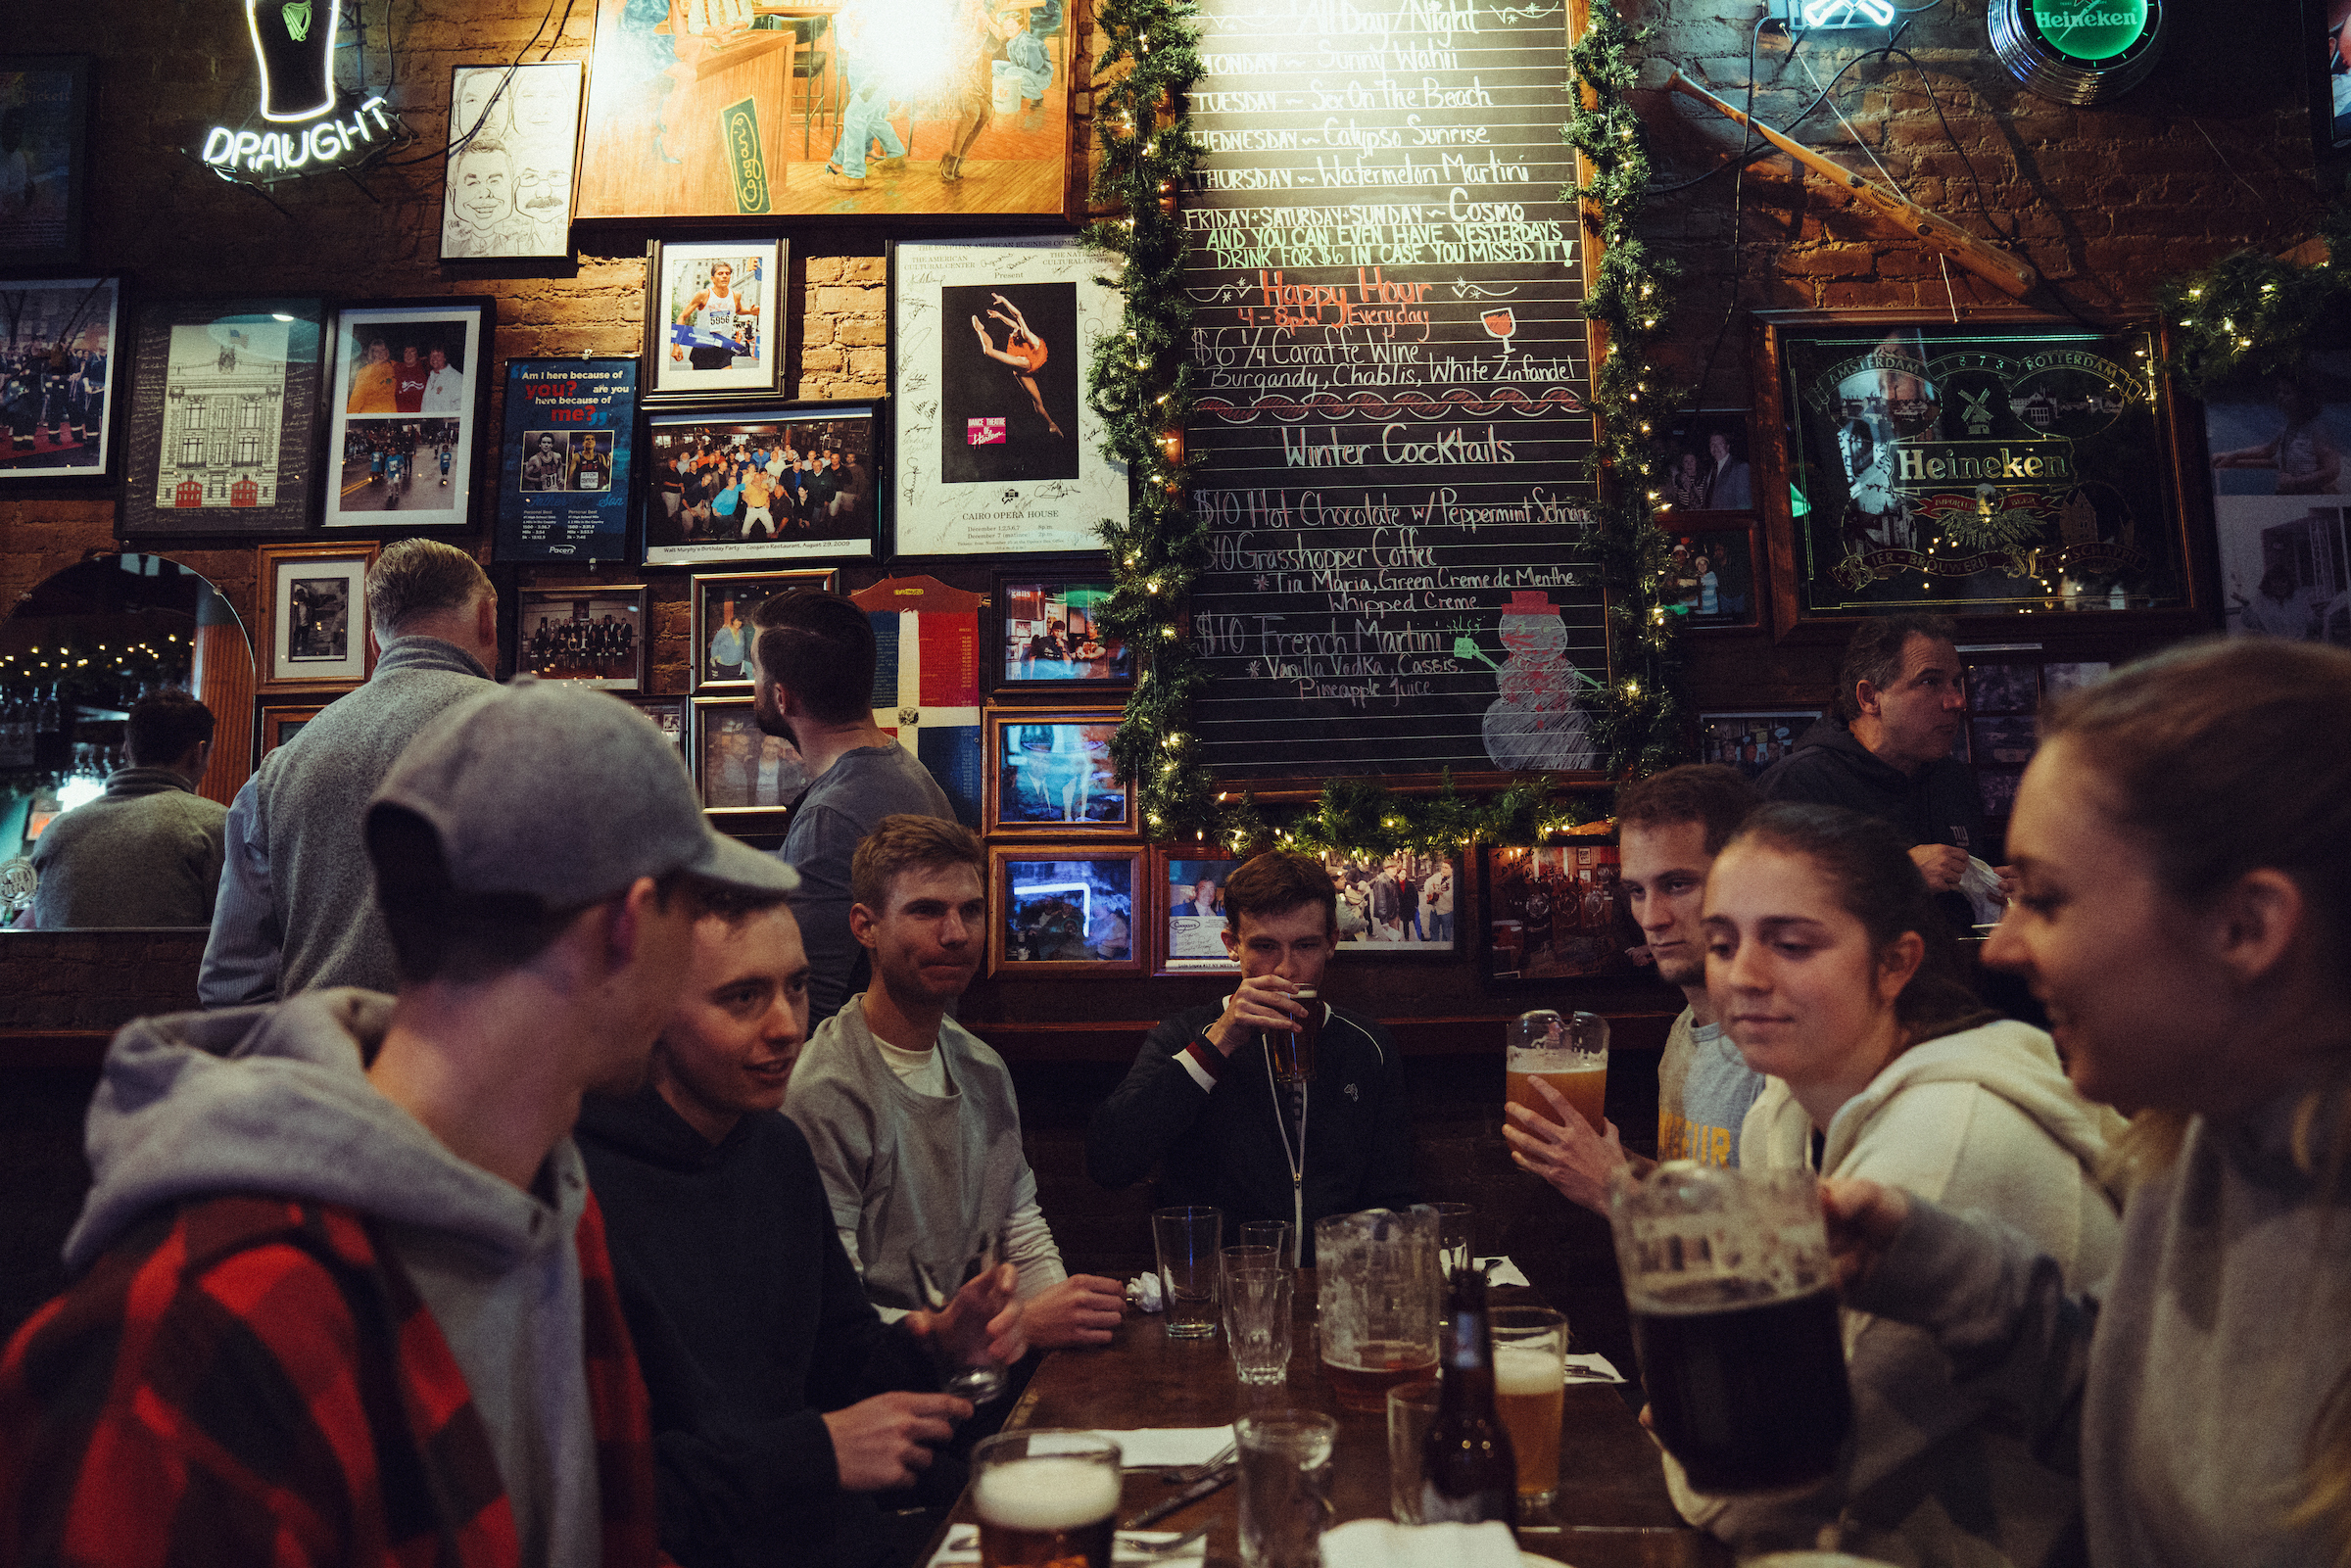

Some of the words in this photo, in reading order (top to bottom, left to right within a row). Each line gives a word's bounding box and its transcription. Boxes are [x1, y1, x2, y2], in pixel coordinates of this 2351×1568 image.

[2034, 10, 2137, 28] Heineken
[1191, 91, 1276, 113] TUESDAY
[1347, 80, 1375, 109] On
[1374, 76, 1418, 108] The
[1422, 75, 1494, 109] Beach
[202, 97, 390, 169] DRAUGHT
[1192, 129, 1298, 152] WEDNESDAY
[1324, 117, 1402, 159] Calypso
[1407, 114, 1490, 145] Sunrise
[1193, 167, 1292, 190] THURSDAY
[1317, 154, 1438, 188] Watermelon
[1442, 149, 1529, 184] Martini
[1450, 186, 1525, 222] Cosmo
[1206, 227, 1246, 252] AND
[1252, 226, 1287, 249] YOU
[1291, 226, 1330, 247] CAN
[1337, 224, 1384, 245] EVEN
[1392, 223, 1445, 245] HAVE
[1451, 217, 1563, 243] YESTERDAY'S
[1214, 247, 1273, 270] DRINK
[1281, 248, 1316, 268] FOR
[1318, 244, 1344, 265] $6
[1351, 245, 1373, 266] IN
[1379, 244, 1426, 264] CASE
[1429, 243, 1465, 264] YOU
[1468, 242, 1536, 263] MISSED
[1259, 269, 1349, 328] Happy
[1358, 266, 1432, 304] Hour
[710, 315, 730, 325] 5956
[1191, 326, 1236, 367] $6
[1272, 326, 1365, 364] Caraffe
[1366, 327, 1423, 364] Wine
[522, 371, 539, 380] Am
[547, 371, 568, 380] here
[570, 370, 610, 380] because
[612, 369, 623, 379] of
[1429, 352, 1488, 383] White
[1492, 354, 1575, 382] Zinfandel
[1828, 354, 1921, 386] AMSTERDAM
[2026, 351, 2117, 380] ROTTERDAM
[525, 379, 578, 401] you?
[535, 396, 556, 405] here
[558, 396, 599, 404] because
[601, 395, 612, 404] of
[593, 383, 609, 394] are
[611, 386, 630, 395] you
[551, 404, 597, 422] me?
[968, 418, 984, 427] DANCE
[972, 429, 1004, 446] Harlem
[1281, 426, 1371, 468] Winter
[1896, 447, 2069, 481] Heineken
[962, 512, 991, 521] CAIRO
[993, 511, 1025, 520] OPERA
[1193, 489, 1241, 525] $10
[1247, 489, 1293, 529] Hot
[1300, 490, 1405, 527] Chocolate
[1440, 486, 1534, 534] Peppermint
[549, 546, 575, 554] Pacers
[1236, 530, 1367, 580] Grasshopper
[1371, 526, 1437, 569] Coffee
[1267, 572, 1306, 594] Tia
[1378, 568, 1434, 591] Green
[1438, 566, 1489, 588] Creme
[1493, 566, 1511, 588] de
[1516, 566, 1574, 587] Menthe
[1328, 592, 1417, 619] Whipped
[1424, 591, 1479, 610] Creme
[1196, 609, 1245, 657] $10
[1253, 615, 1348, 657] French
[1356, 617, 1442, 655] Martini
[1264, 654, 1323, 680] Vanilla
[1289, 677, 1380, 708] Pineapple
